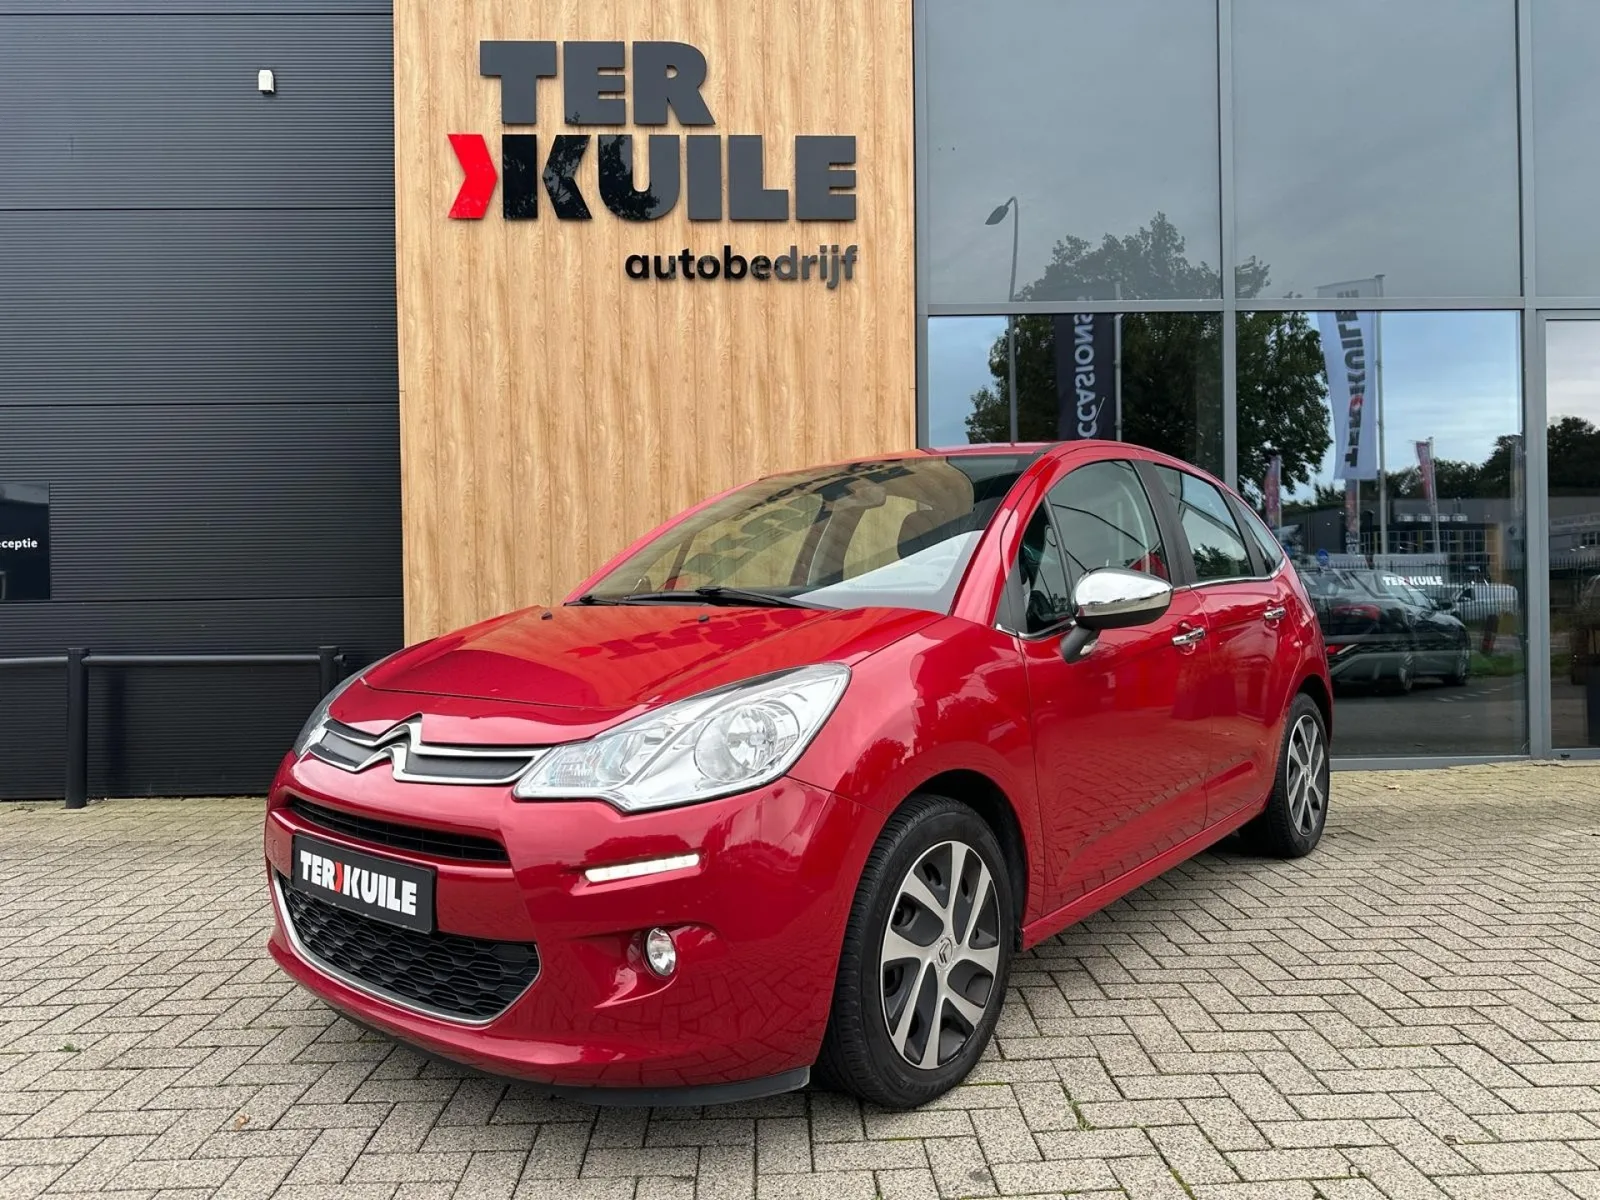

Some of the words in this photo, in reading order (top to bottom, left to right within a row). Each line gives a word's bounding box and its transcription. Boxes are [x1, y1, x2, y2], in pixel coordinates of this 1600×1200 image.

[480, 41, 716, 125] TER
[502, 134, 857, 221] KUILE
[625, 245, 859, 289] autobedrijf
[0, 538, 38, 550] ceptie
[1408, 575, 1444, 586] KUILE
[299, 849, 336, 891] TER
[343, 864, 417, 916] KUILE
